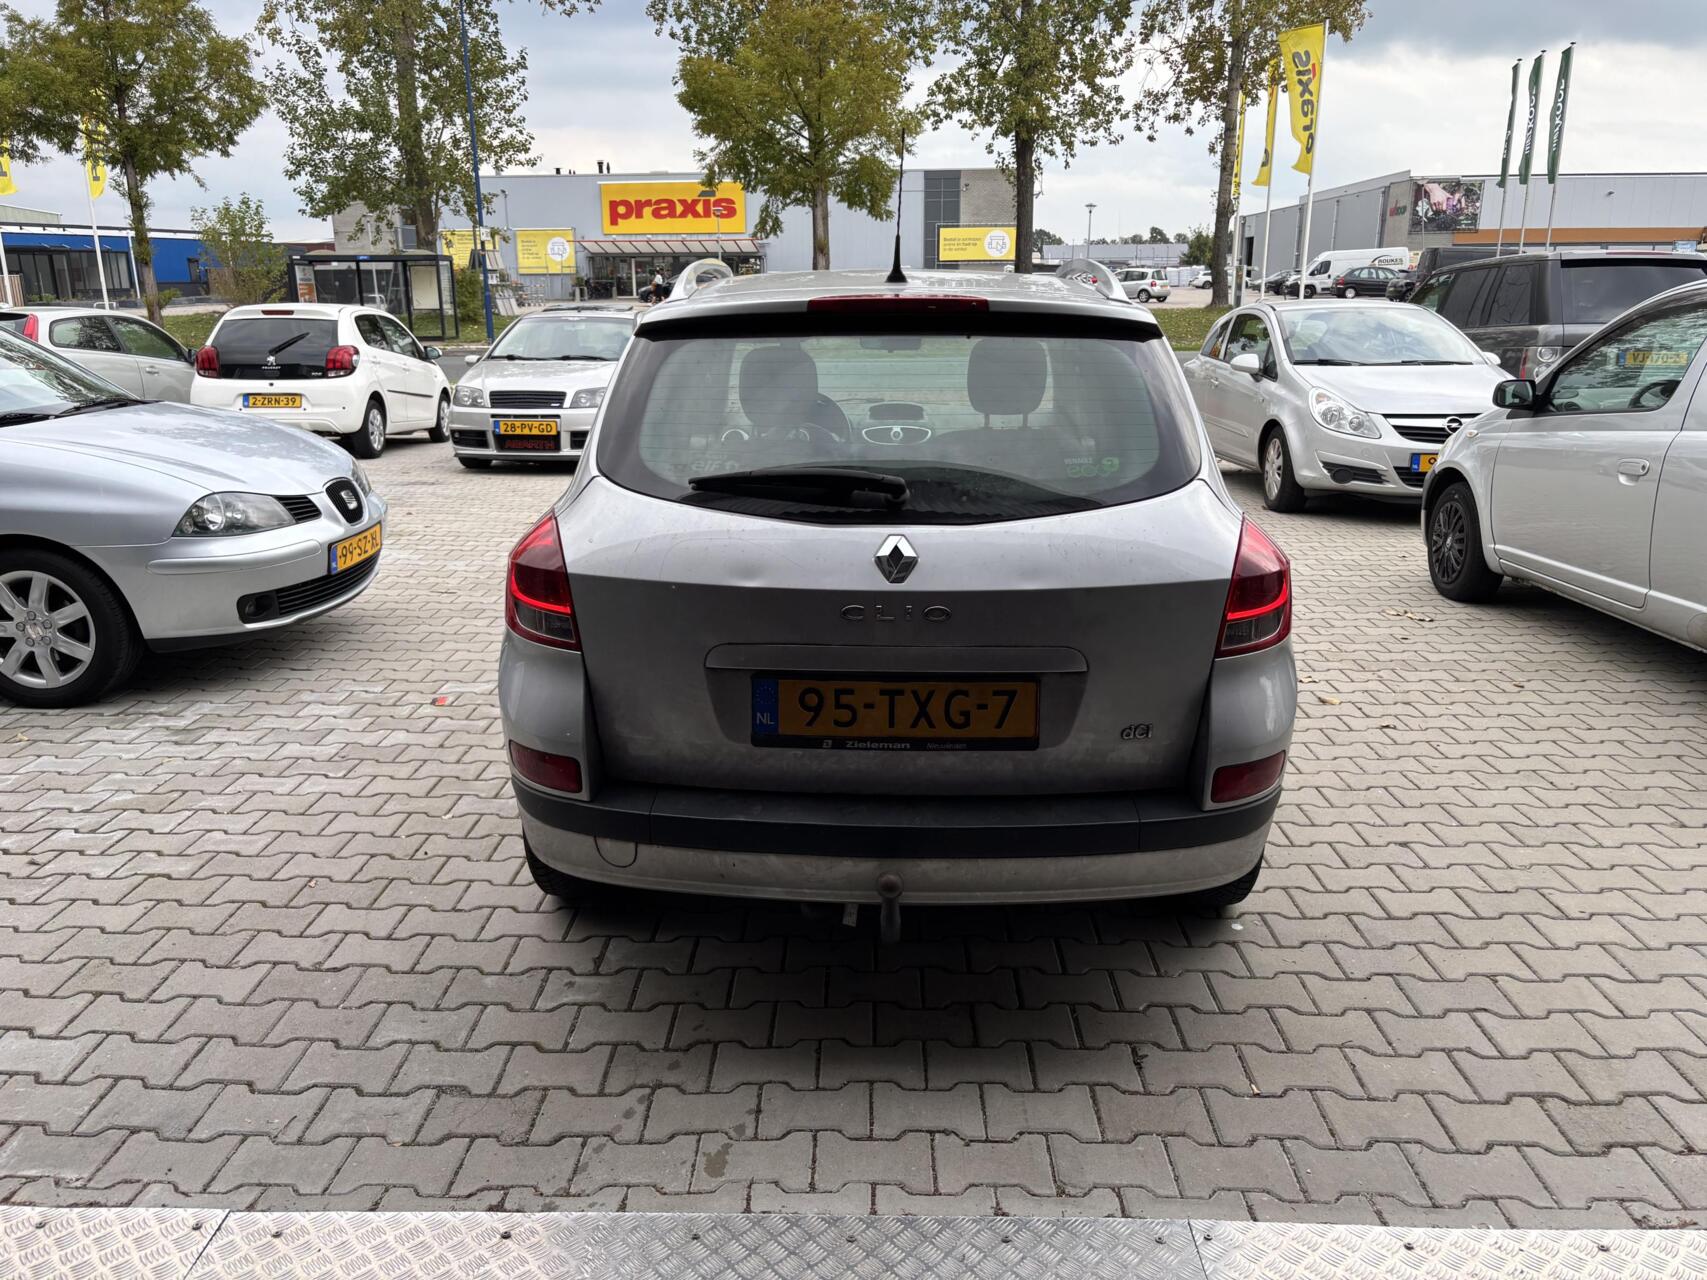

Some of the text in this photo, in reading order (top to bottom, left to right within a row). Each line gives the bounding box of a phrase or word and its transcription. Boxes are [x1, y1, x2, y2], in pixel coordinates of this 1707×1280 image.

[609, 190, 737, 226] praxis
[252, 396, 297, 406] 2-ZRN-39
[503, 422, 553, 433] 28-PV-GD
[841, 604, 952, 622] CLIO
[756, 687, 1018, 730] NL 95-TXG-7
[845, 740, 911, 749] Zieleman
